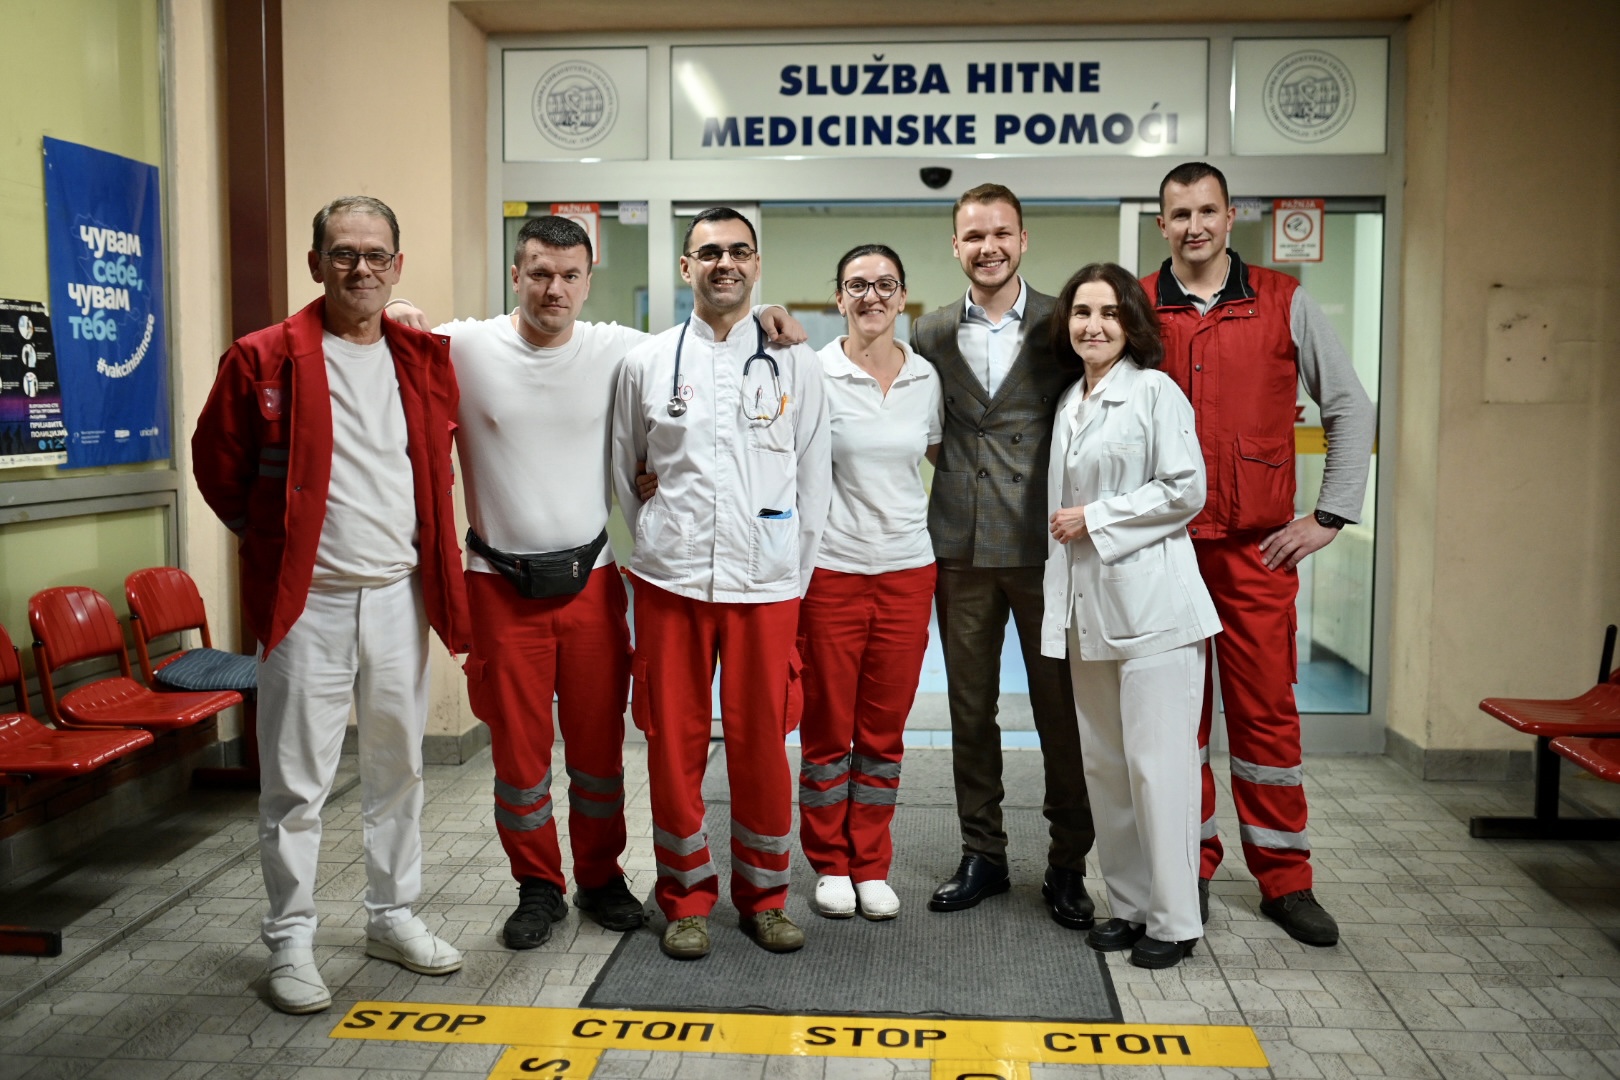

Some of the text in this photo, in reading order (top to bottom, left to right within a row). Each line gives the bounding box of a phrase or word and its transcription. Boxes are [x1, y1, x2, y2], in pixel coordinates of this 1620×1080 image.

[779, 53, 1101, 97] SLUŽBA HITNE
[702, 102, 1180, 148] MEDICINSKE POMOĆI
[557, 203, 592, 213] PAŽNJA
[1280, 199, 1316, 209] PAŽNJA
[79, 225, 142, 258] чувам
[92, 255, 143, 291] себе,
[67, 282, 130, 316] чувам
[68, 309, 117, 341] тебе
[343, 1009, 486, 1033] STOP
[572, 1018, 715, 1042] СТОП
[805, 1026, 947, 1048] STOP
[1044, 1032, 1192, 1055] СТОП
